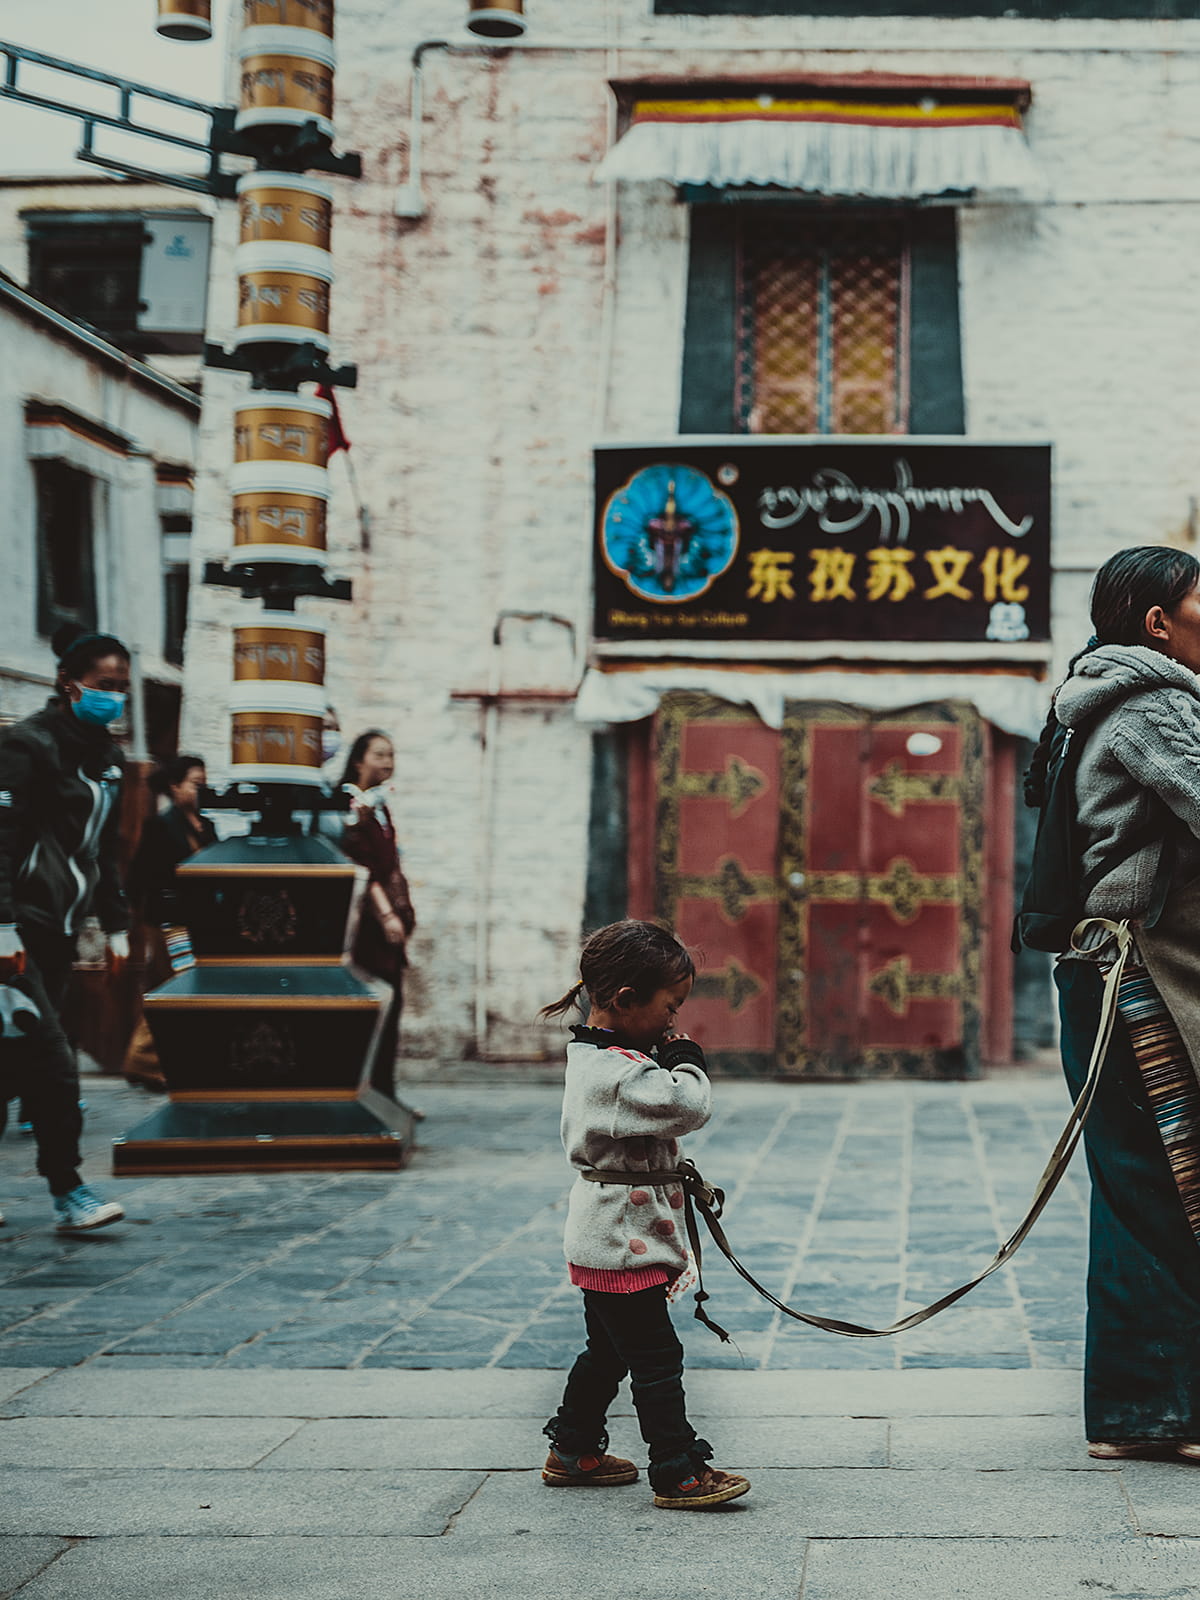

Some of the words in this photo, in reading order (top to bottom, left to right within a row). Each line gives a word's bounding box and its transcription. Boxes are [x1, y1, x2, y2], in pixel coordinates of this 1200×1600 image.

[746, 545, 1031, 603] 东孜苏文化
